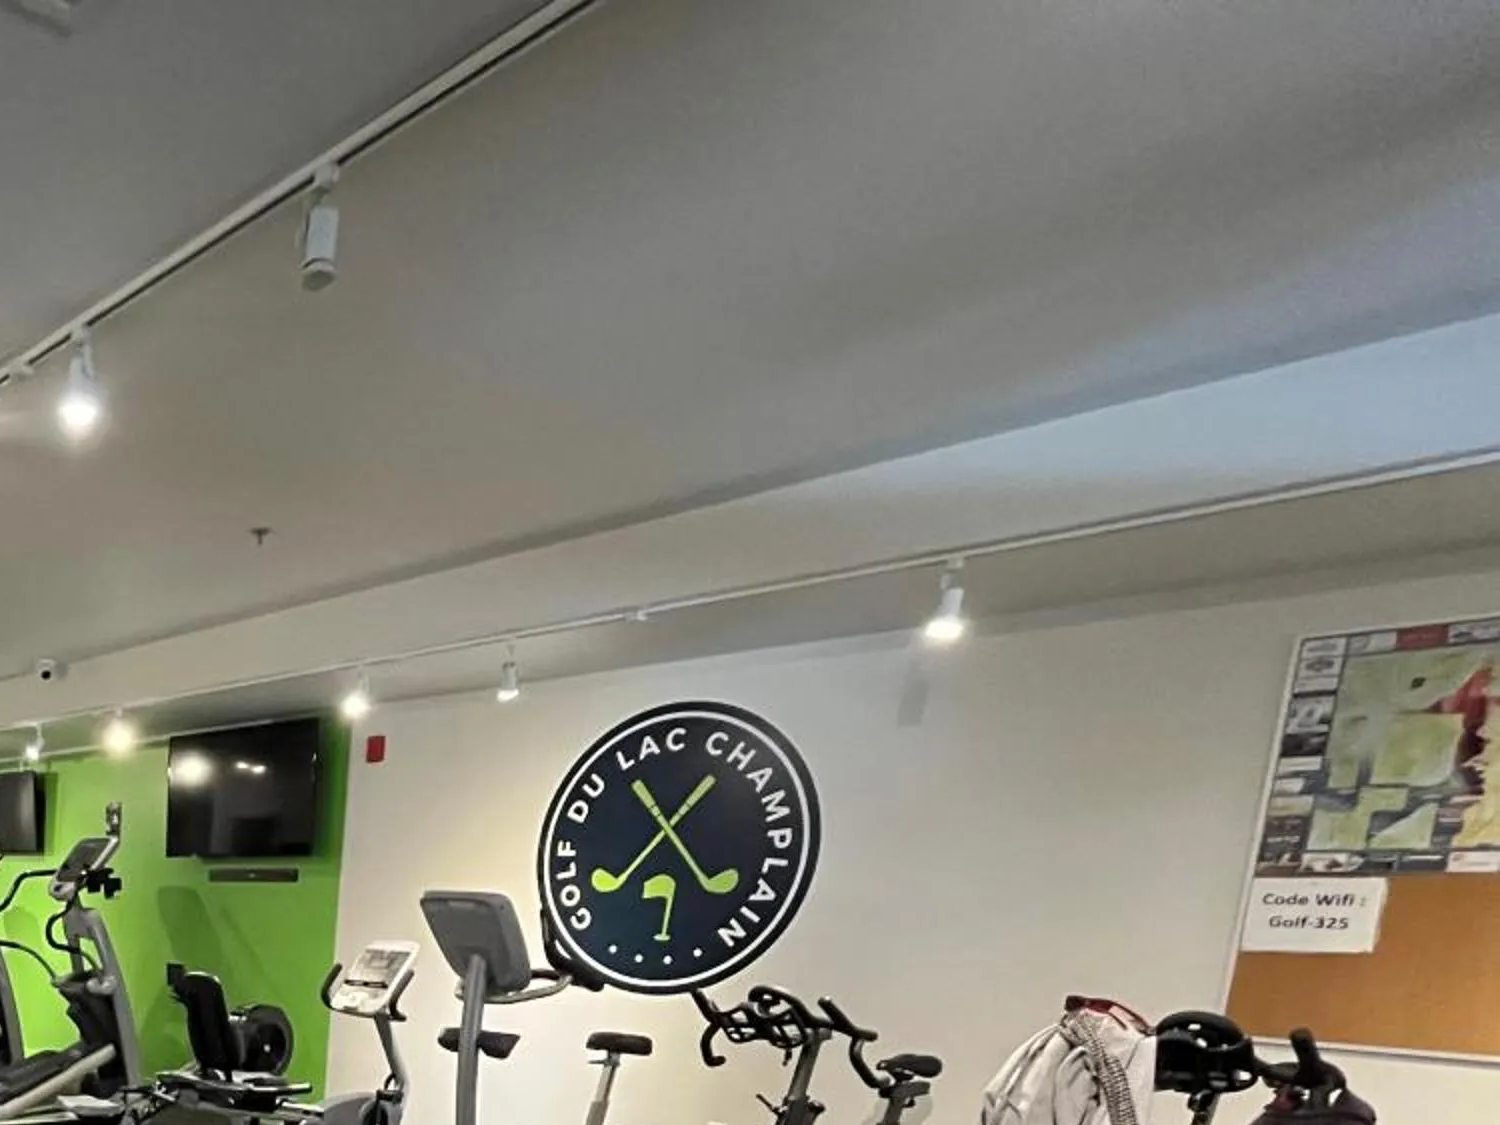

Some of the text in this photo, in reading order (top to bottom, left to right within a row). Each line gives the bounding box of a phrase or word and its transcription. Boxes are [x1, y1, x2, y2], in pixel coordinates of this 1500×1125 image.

[556, 727, 793, 947] GOLF DU LAC CHAMPLAIN
[1262, 893, 1309, 906] Code
[1315, 893, 1355, 906] Wifi
[1269, 915, 1349, 929] Golf-325
